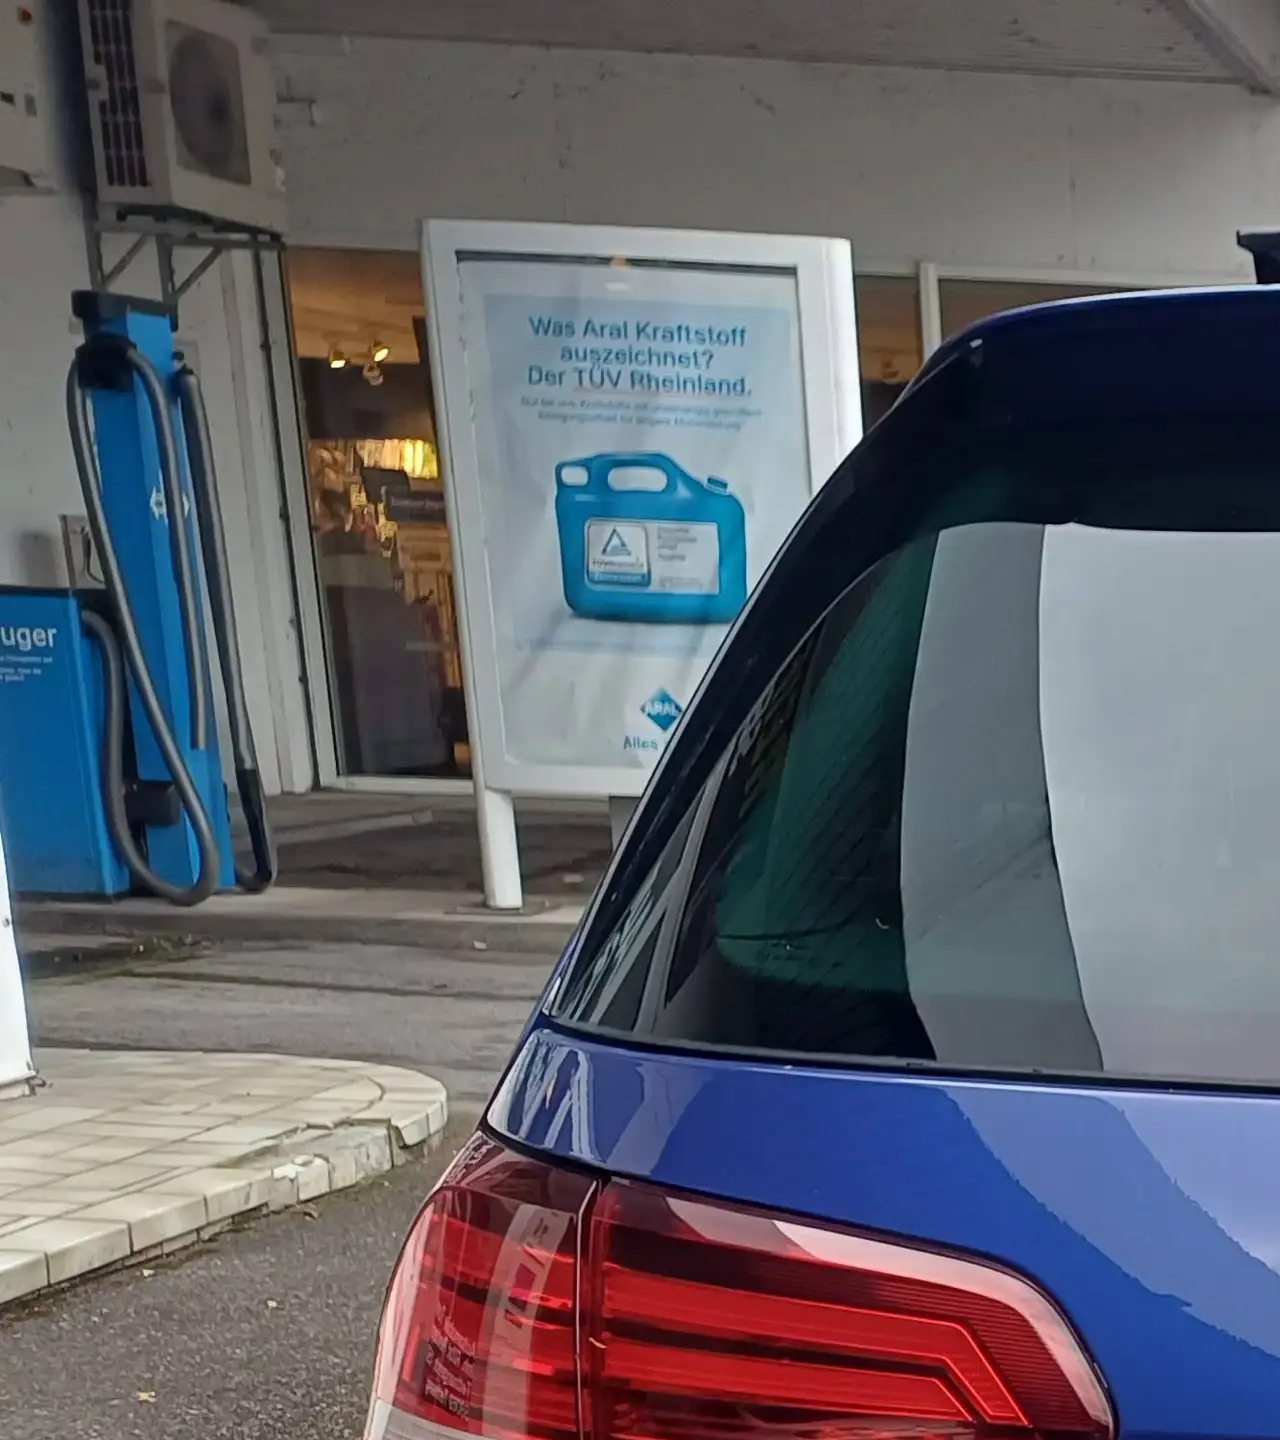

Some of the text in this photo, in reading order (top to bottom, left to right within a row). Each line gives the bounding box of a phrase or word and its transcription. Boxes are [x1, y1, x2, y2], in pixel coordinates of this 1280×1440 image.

[529, 315, 748, 348] Was Aral Kraftstoff
[560, 344, 715, 371] auszeichnet?
[528, 361, 753, 398] Der TÜV Rheinland.
